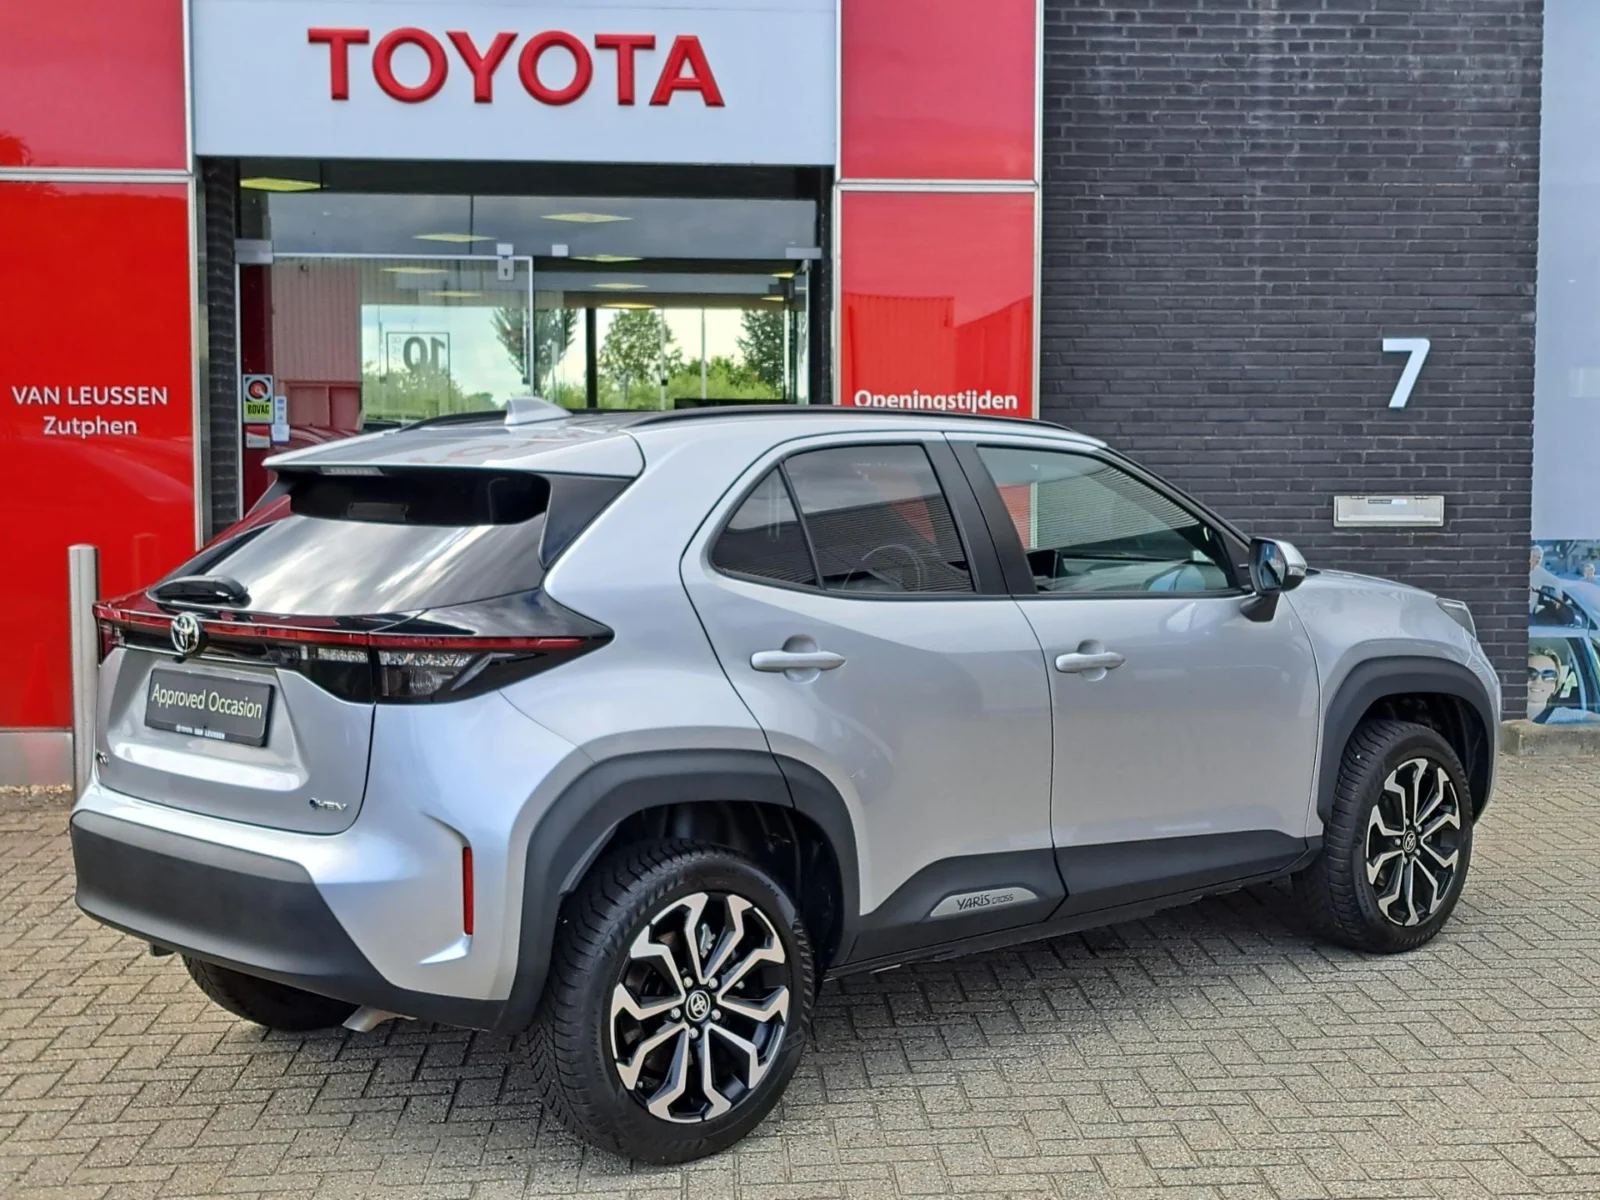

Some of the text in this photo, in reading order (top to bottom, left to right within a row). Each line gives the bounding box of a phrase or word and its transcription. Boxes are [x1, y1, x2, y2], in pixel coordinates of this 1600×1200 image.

[308, 27, 726, 107] TOYOTA
[1382, 337, 1431, 410] 7
[11, 385, 168, 406] VAN LEUSSEN
[854, 389, 1018, 413] Openingstijden
[247, 404, 270, 415] BOVAG
[43, 415, 137, 439] Zutphen
[151, 683, 263, 719] Approved Occasion
[991, 893, 1014, 905] CROSS
